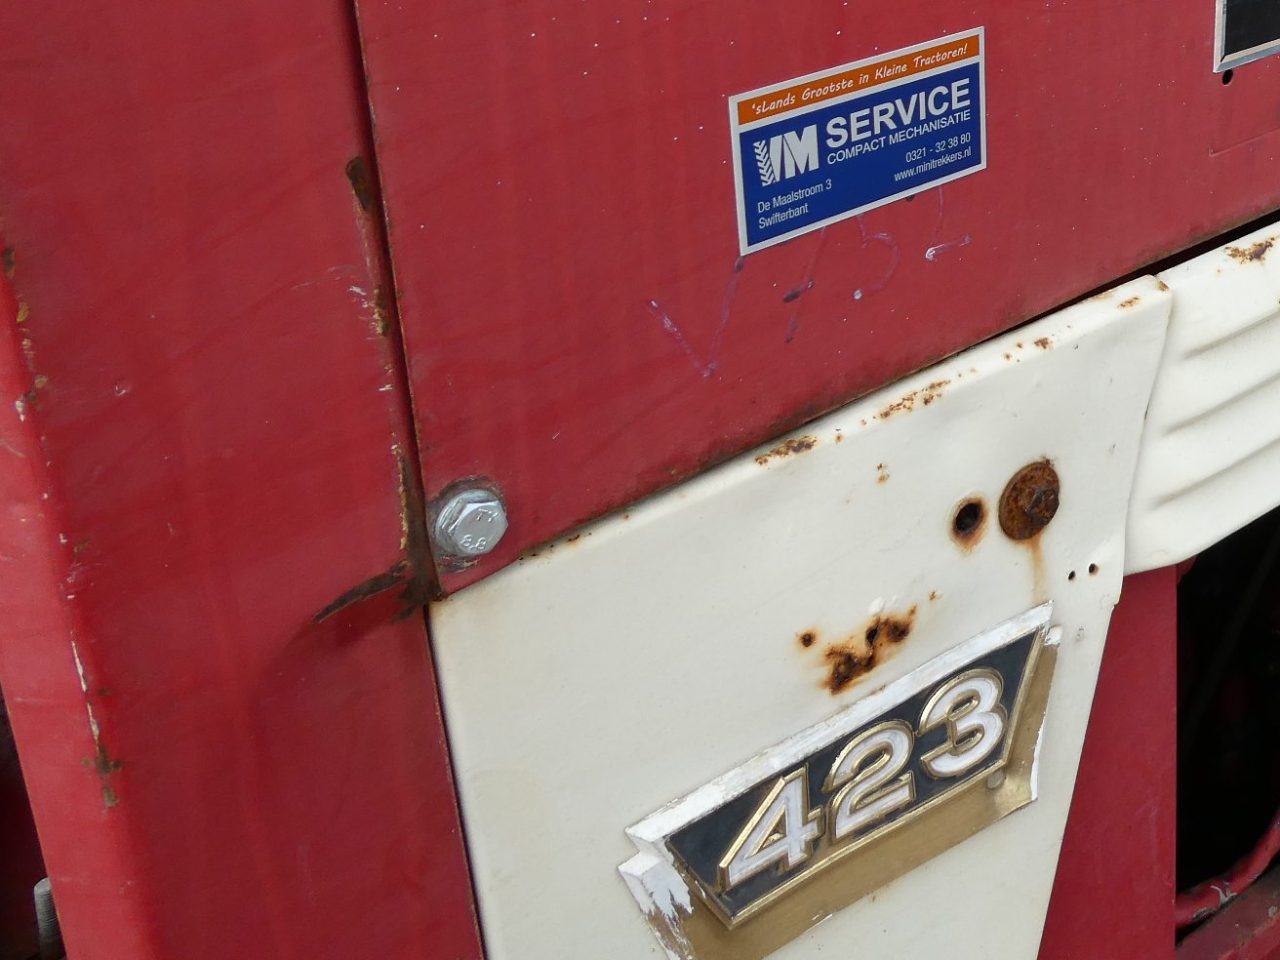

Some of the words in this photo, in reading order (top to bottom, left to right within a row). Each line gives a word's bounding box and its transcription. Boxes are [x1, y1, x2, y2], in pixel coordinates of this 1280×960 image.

[801, 79, 854, 101] Grootste
[858, 73, 869, 85] in
[874, 63, 908, 80] Kleine
[913, 43, 968, 68] Tractoren!
[825, 77, 971, 148] SERVICE
[827, 136, 887, 165] COMPACT
[889, 109, 971, 145] MECHANISATIE
[905, 147, 927, 163] 0321
[934, 140, 946, 153] 32
[947, 136, 959, 149] 38
[960, 131, 971, 145] 80
[894, 145, 972, 182] www.minitrekkers.nl
[757, 201, 771, 214] De
[772, 182, 824, 209] Maalstroom
[825, 178, 832, 190] 3
[758, 203, 809, 229] Swifterbant
[718, 666, 1008, 891] 423
